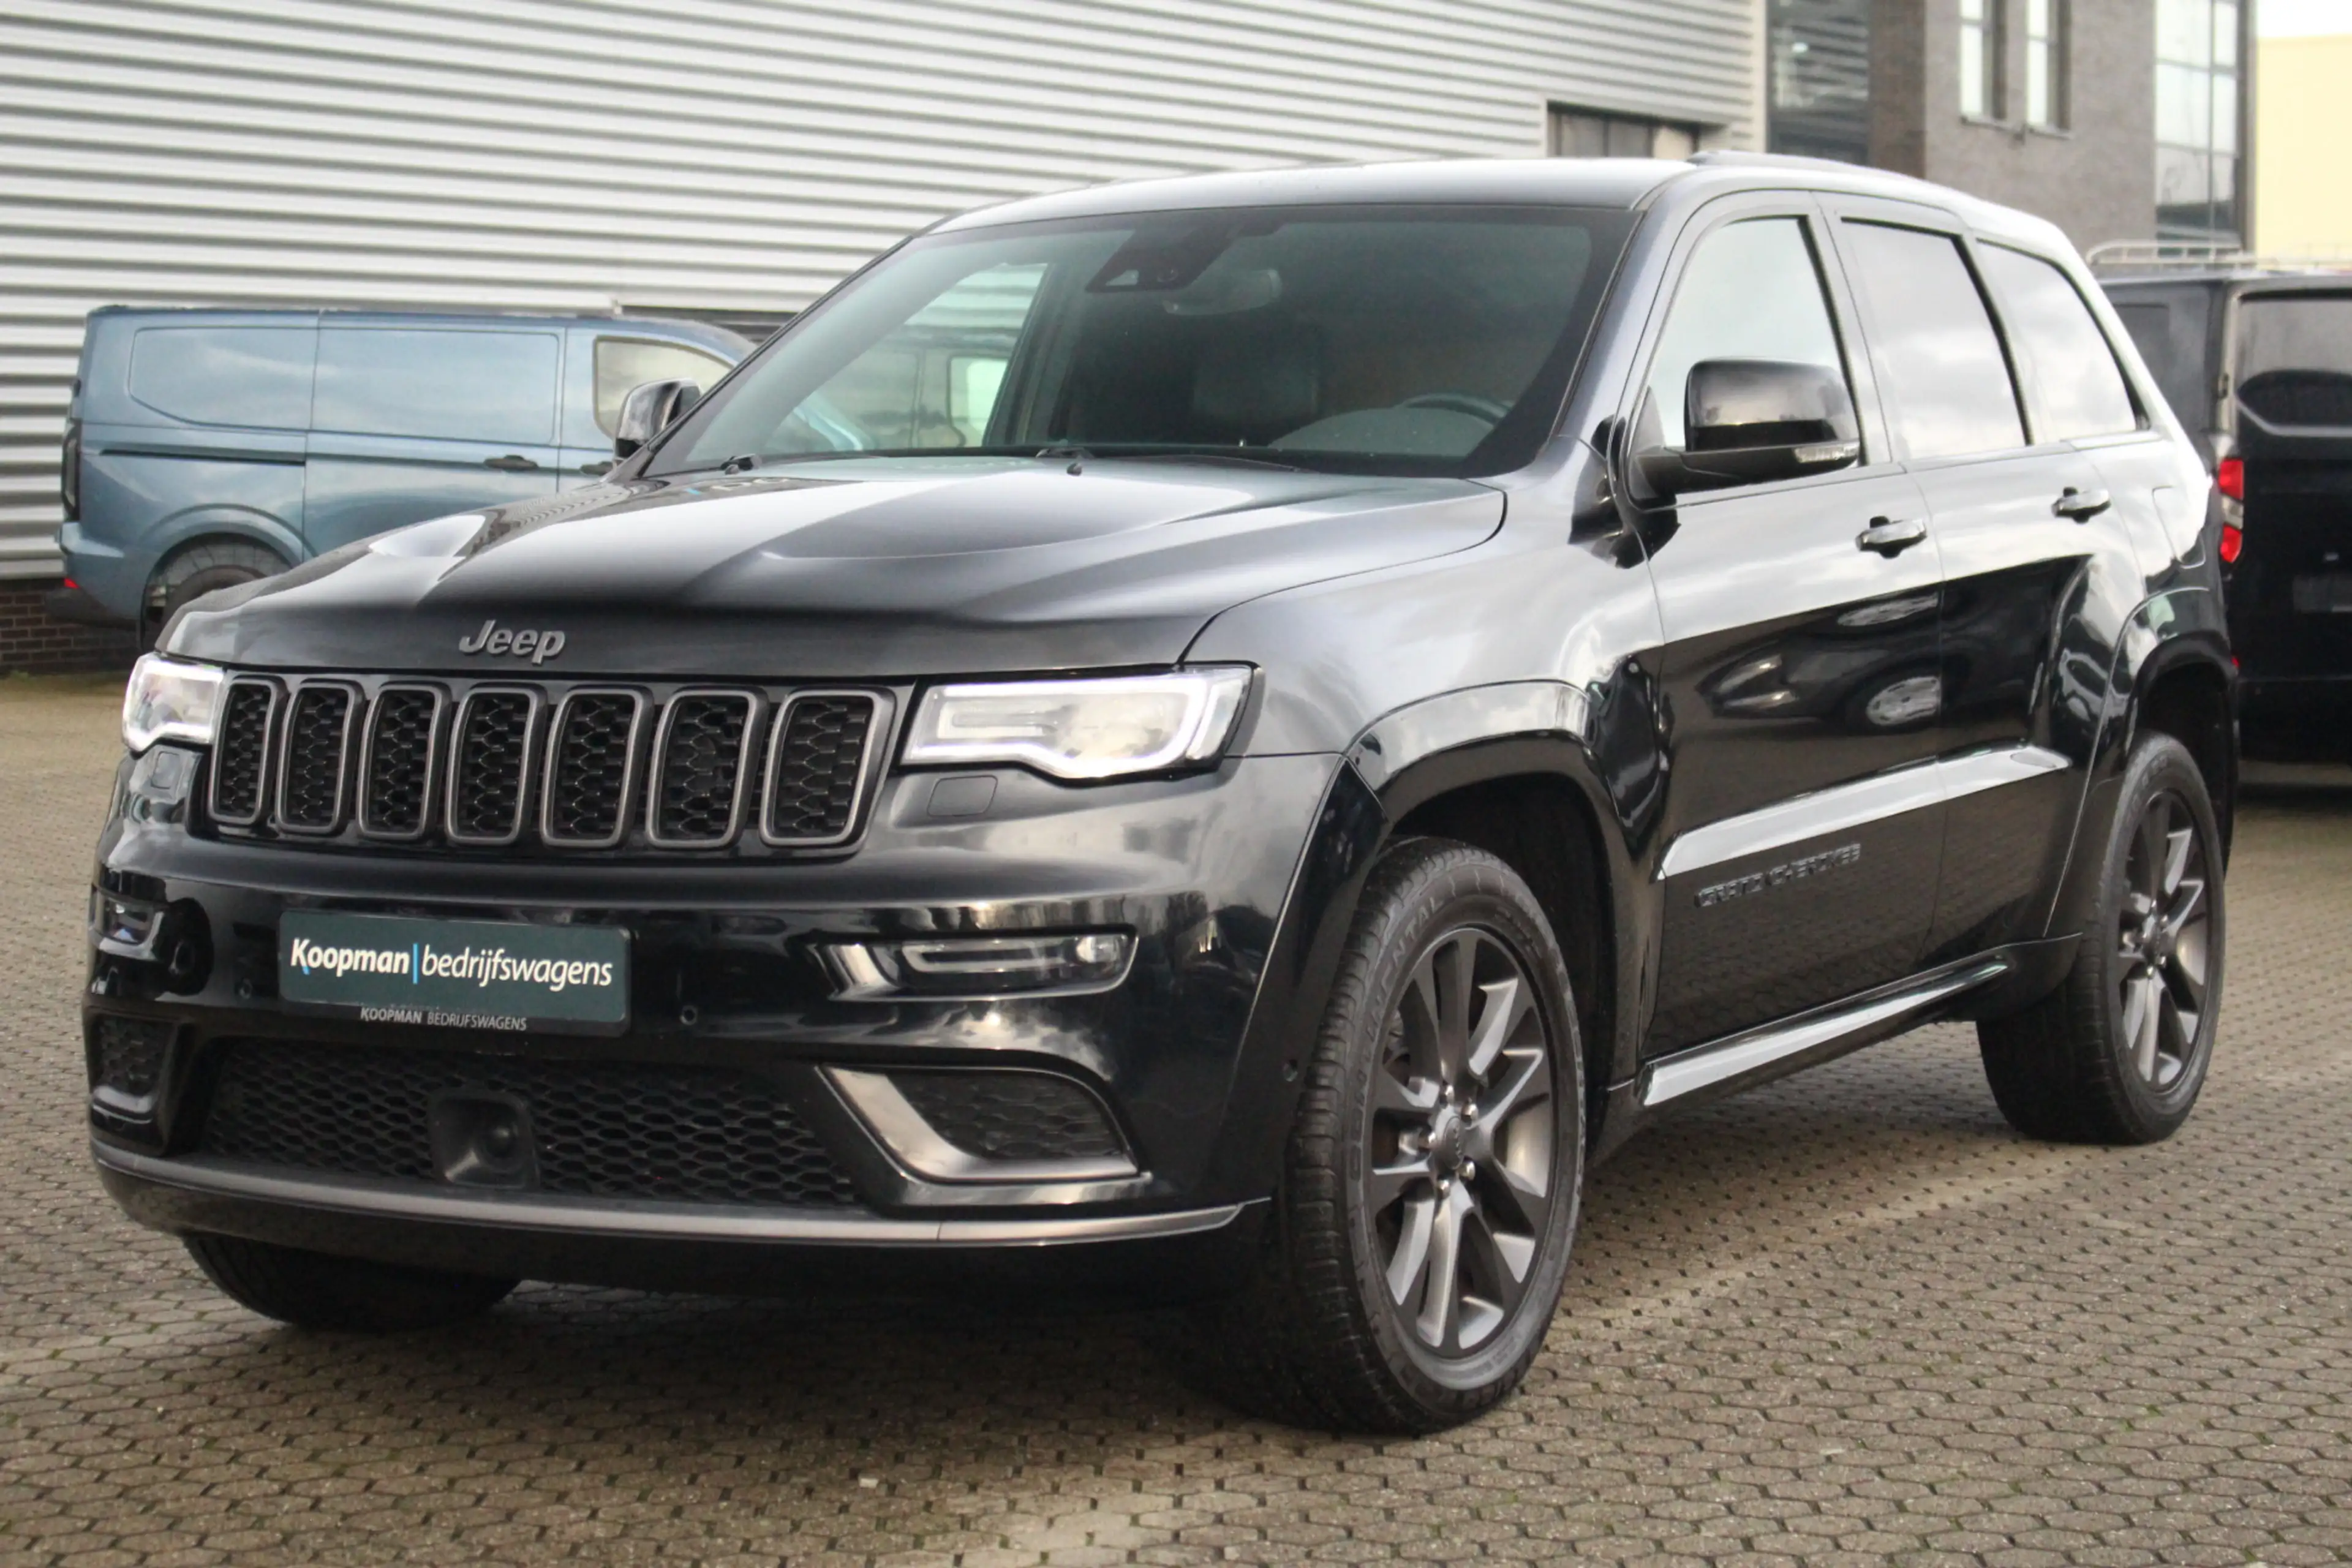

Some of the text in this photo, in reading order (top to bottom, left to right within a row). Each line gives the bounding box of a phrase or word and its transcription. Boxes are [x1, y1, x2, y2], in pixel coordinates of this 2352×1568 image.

[458, 619, 565, 665] Jeep
[290, 937, 613, 992] Koopman bedrijfswagens
[360, 1006, 527, 1031] KOOPMAN BEDRIJFSWAGENS
